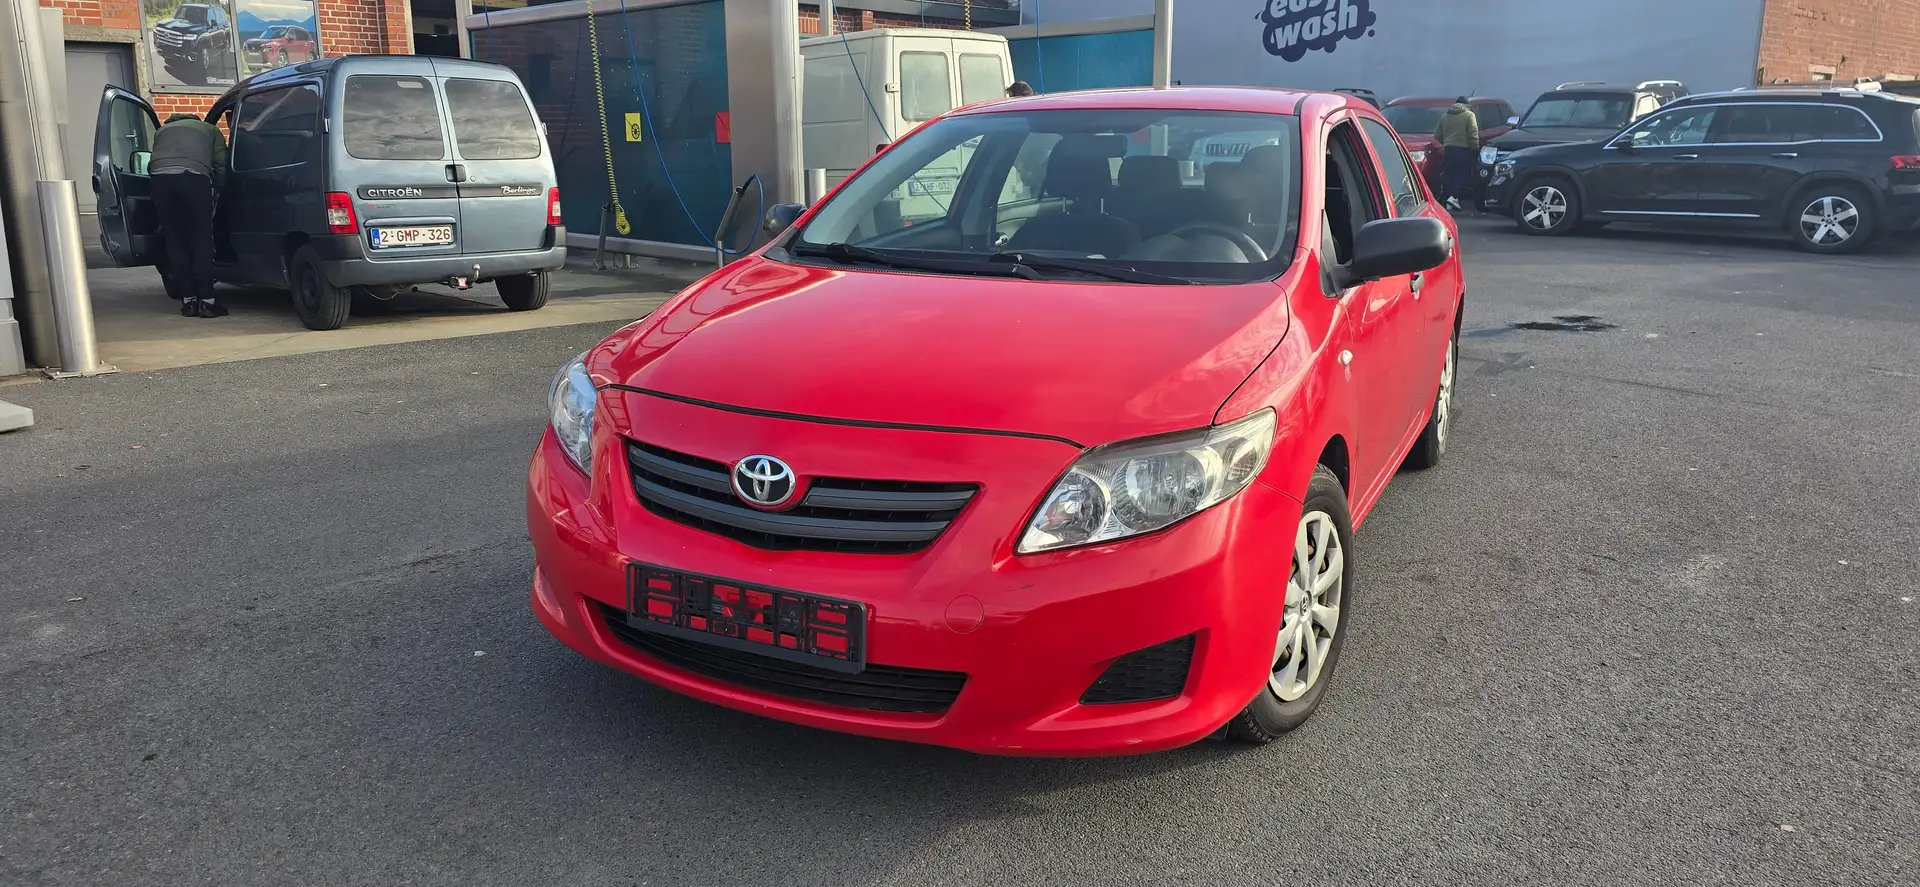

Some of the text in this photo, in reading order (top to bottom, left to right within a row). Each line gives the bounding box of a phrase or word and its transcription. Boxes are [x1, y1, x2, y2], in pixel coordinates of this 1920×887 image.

[1275, 0, 1358, 49] wash
[368, 187, 422, 197] CITROËN
[501, 185, 536, 195] Berlingo
[381, 229, 450, 242] 2-GMP-326
